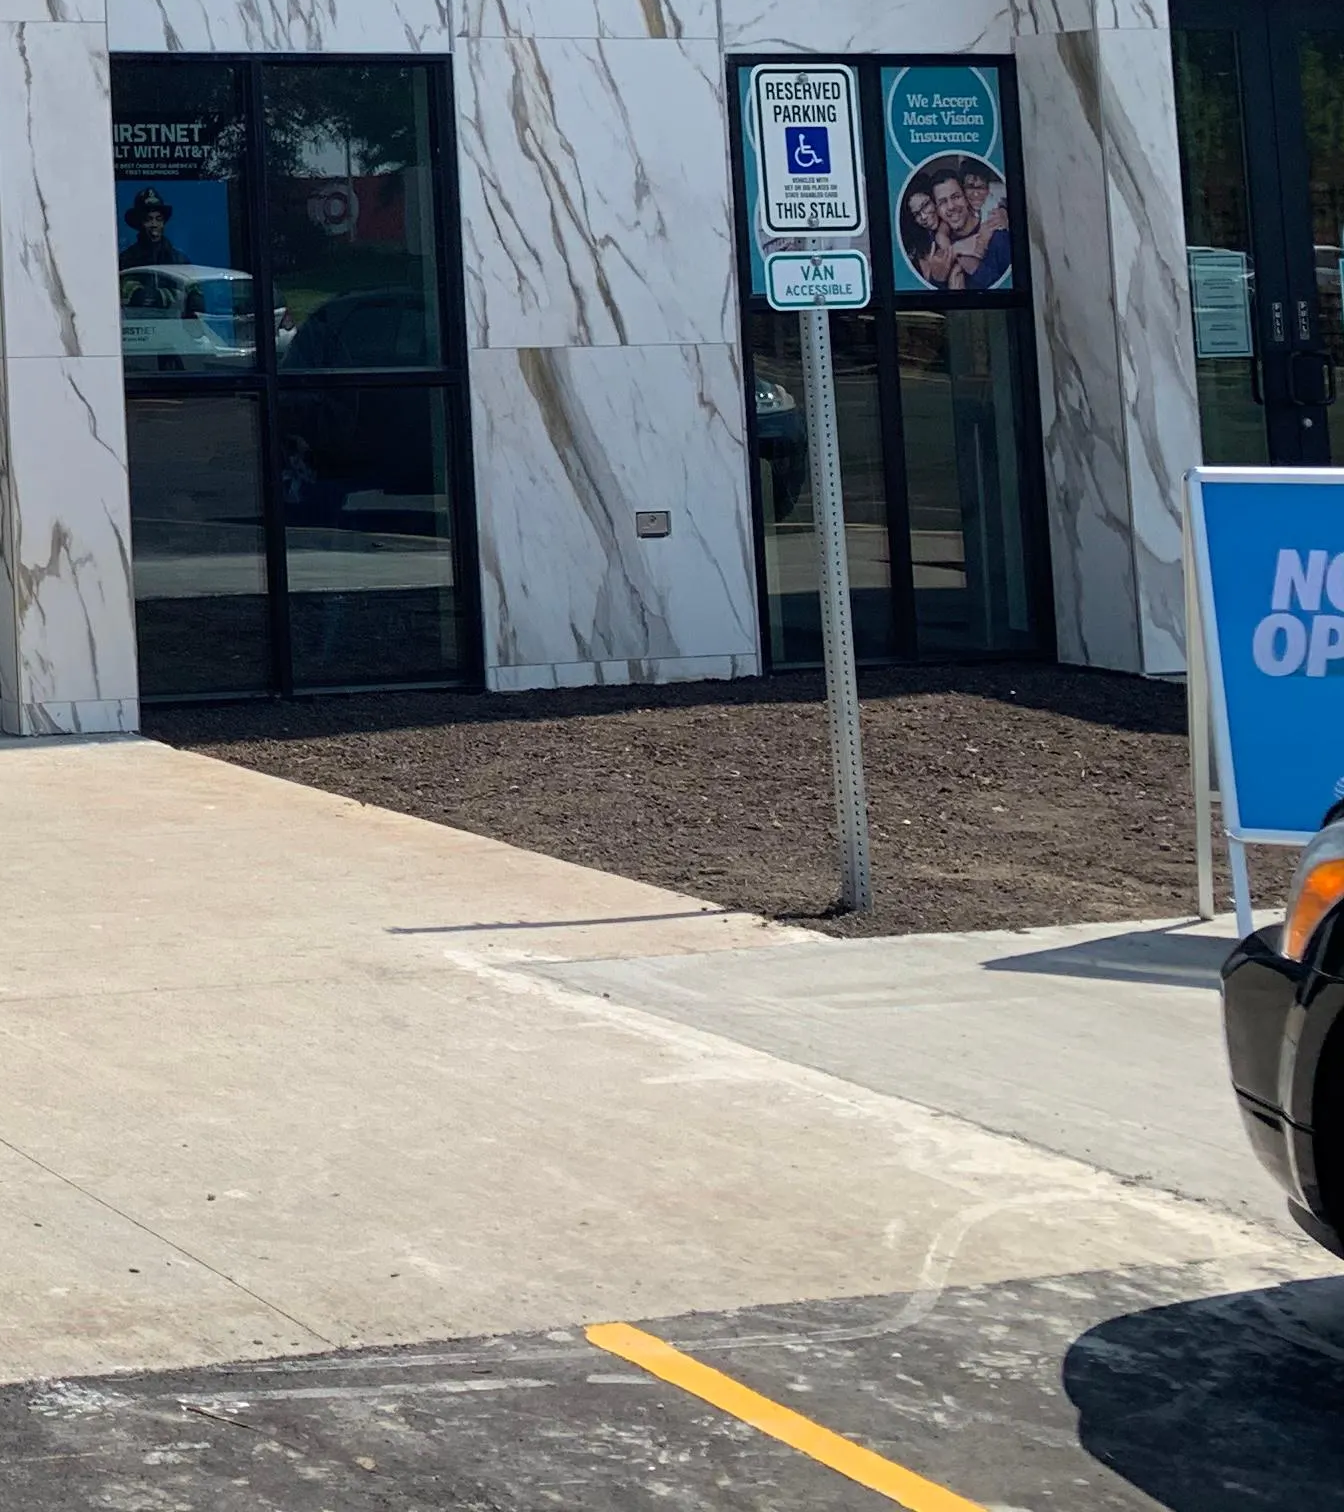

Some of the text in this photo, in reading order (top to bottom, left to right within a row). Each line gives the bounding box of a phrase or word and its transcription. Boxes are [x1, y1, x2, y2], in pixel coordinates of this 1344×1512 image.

[766, 82, 841, 100] RESERVED
[906, 94, 979, 114] We Accept
[774, 104, 837, 123] PARKING
[903, 110, 985, 126] Most Vision
[114, 123, 202, 143] IRSTNET
[909, 129, 980, 144] Insurance
[133, 145, 170, 158] WITH
[174, 145, 213, 158] AT&T
[776, 201, 850, 219] THIS STALL
[801, 265, 835, 281] VAN
[785, 283, 853, 297] ACCESSIBLE
